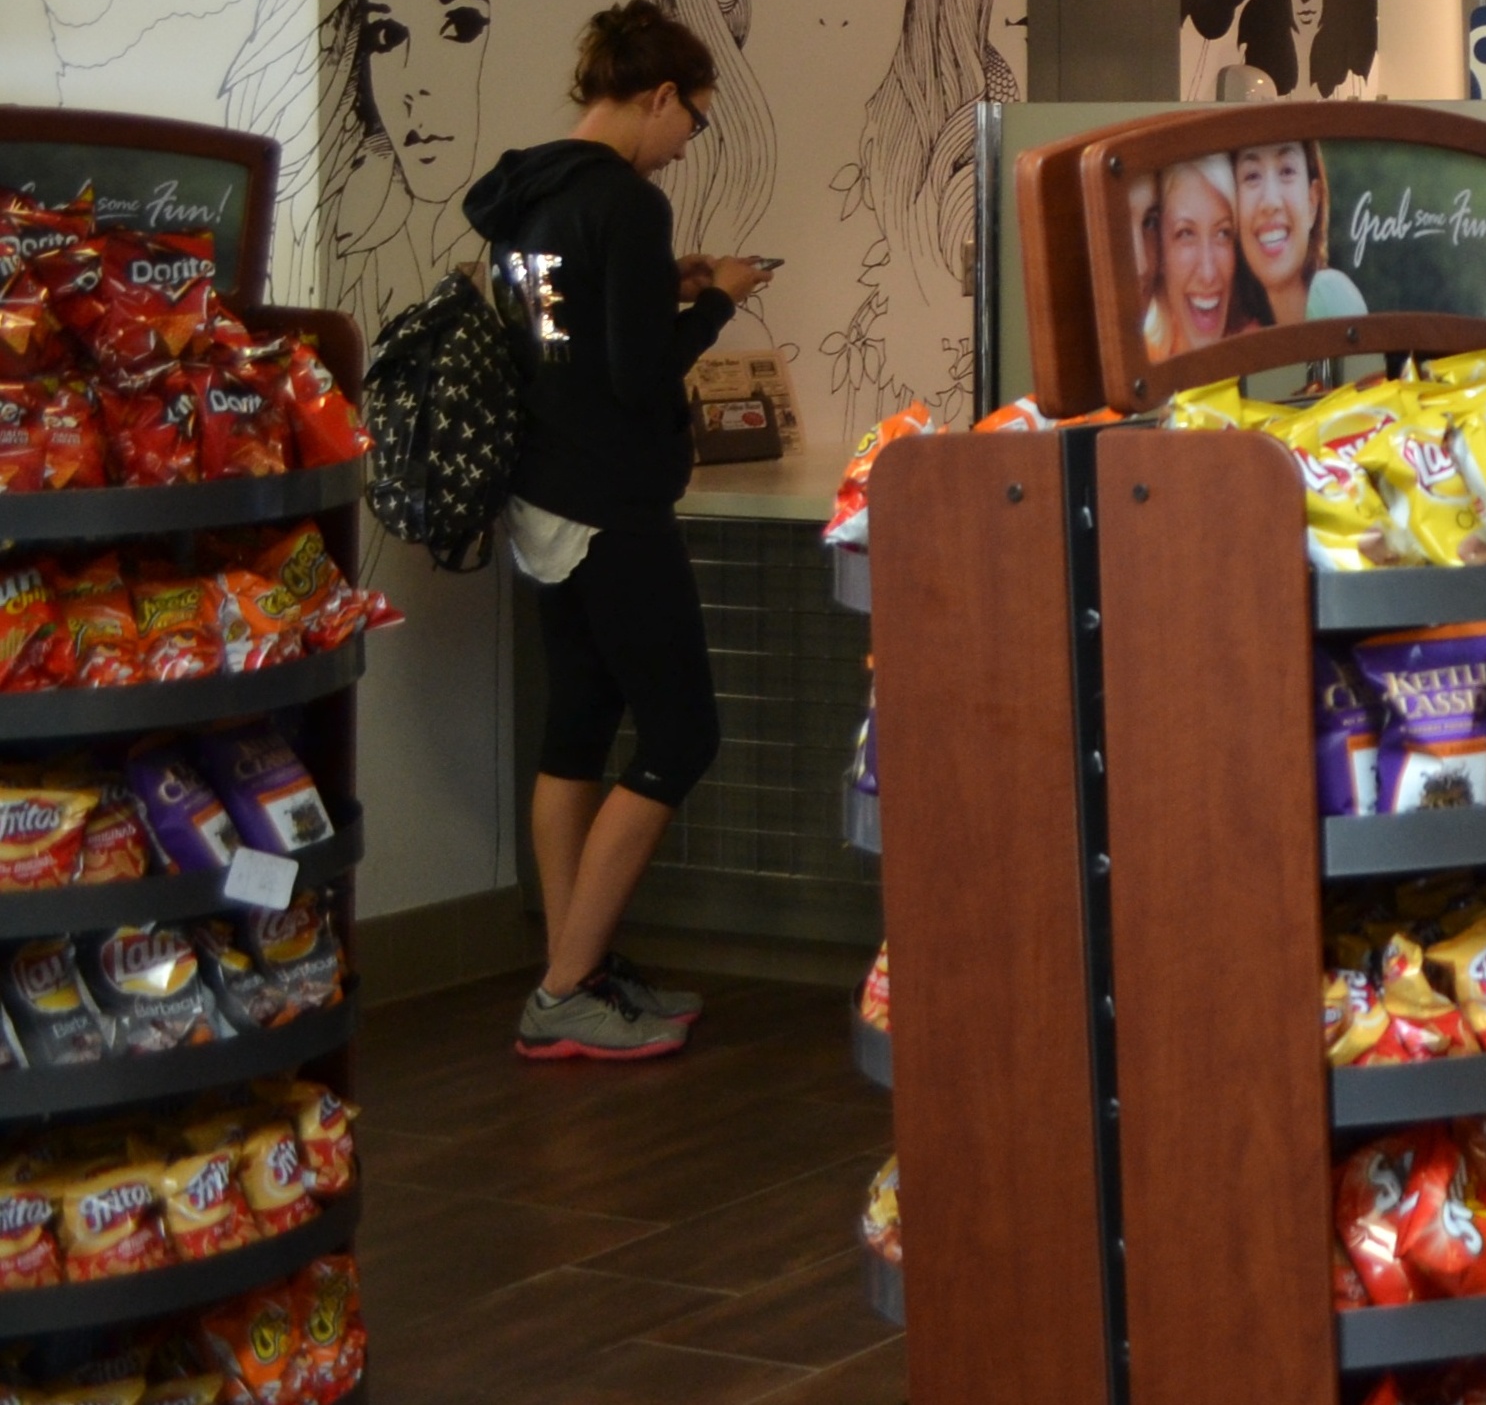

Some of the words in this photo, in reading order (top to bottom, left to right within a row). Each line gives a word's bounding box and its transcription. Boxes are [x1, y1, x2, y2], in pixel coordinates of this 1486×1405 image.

[97, 196, 139, 213] some
[146, 179, 233, 227] Fun!
[1350, 188, 1412, 267] Grab
[1415, 212, 1447, 231] some
[131, 258, 216, 284] Dorito
